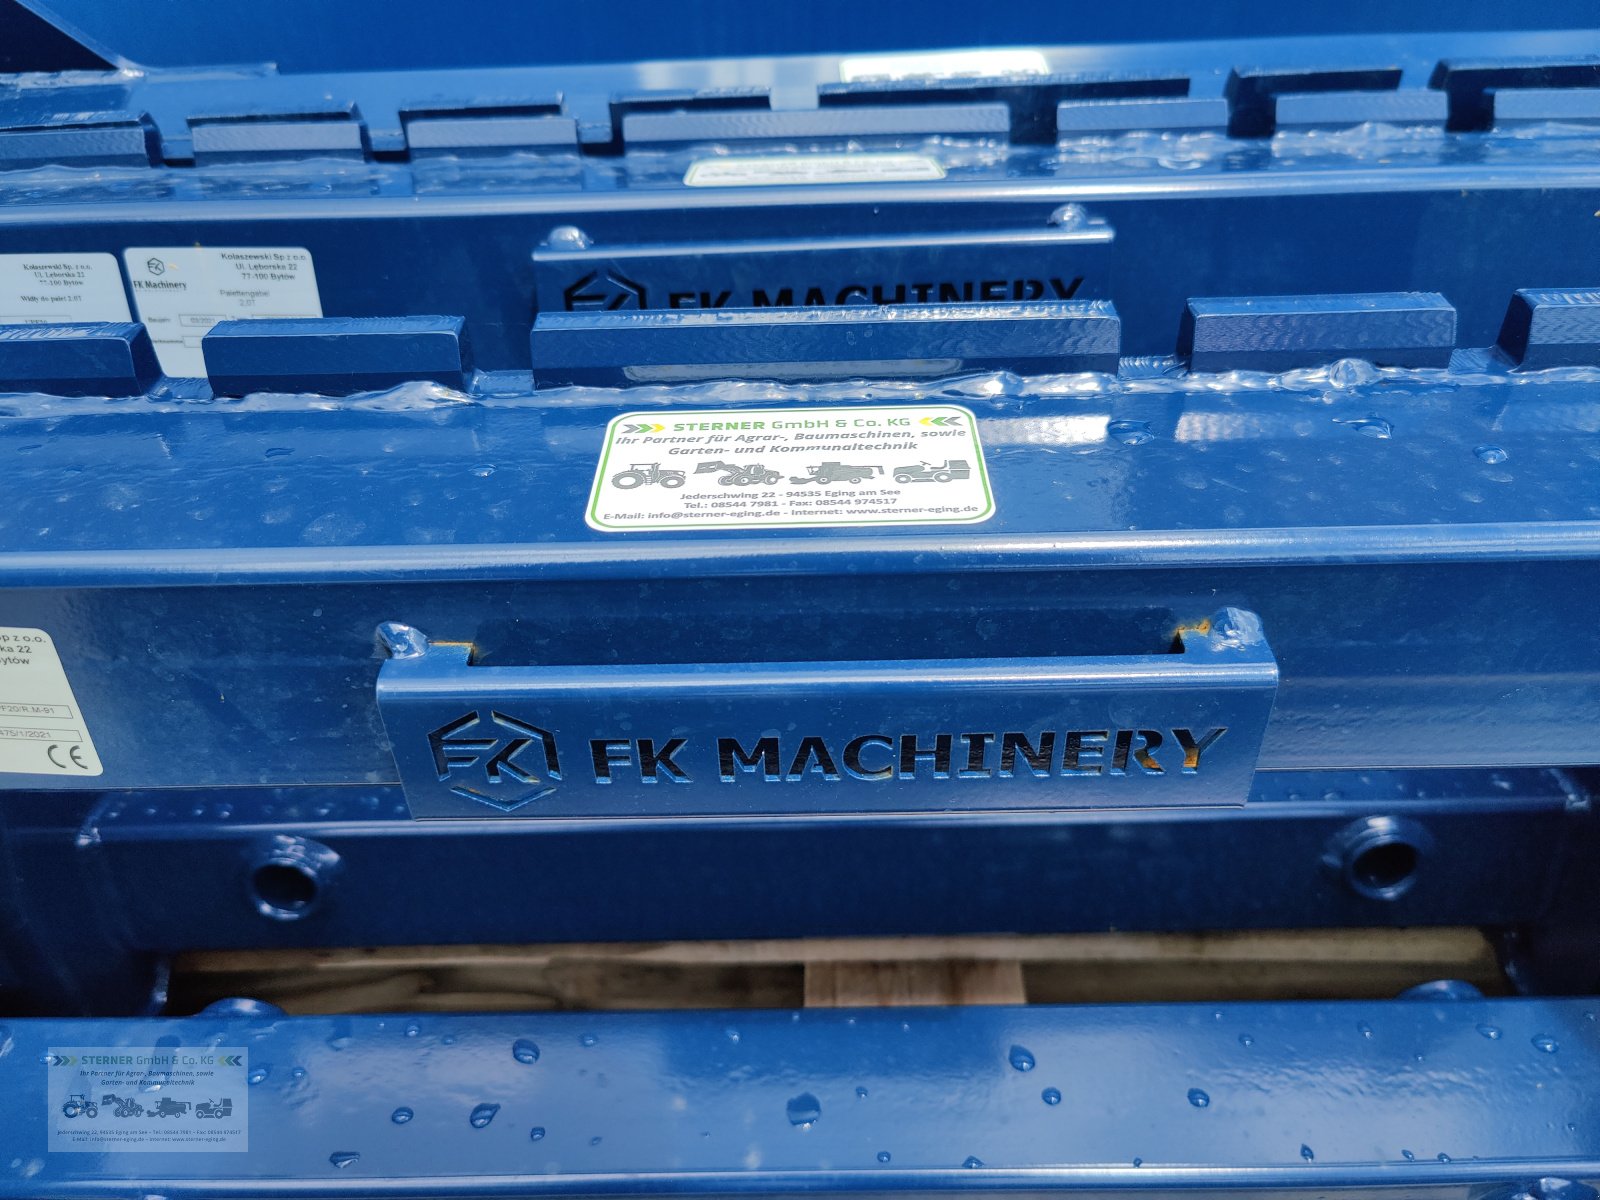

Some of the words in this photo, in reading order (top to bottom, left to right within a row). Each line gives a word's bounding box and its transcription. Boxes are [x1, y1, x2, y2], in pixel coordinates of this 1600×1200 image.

[133, 280, 144, 289] FK
[145, 280, 187, 291] Machinery
[673, 421, 766, 432] STERNER
[771, 419, 829, 430] GmbH
[834, 418, 848, 428] &
[853, 418, 882, 427] Co.
[887, 417, 911, 426] KG
[615, 436, 640, 445] Ihr
[642, 434, 704, 445] Partner
[705, 434, 732, 445] für
[734, 433, 788, 444] Agrar-,
[794, 430, 915, 440] Baumaschinen,
[920, 428, 967, 438] sowie
[668, 446, 730, 456] Garten-
[734, 445, 766, 454] und
[769, 441, 918, 454] Kommunaltechnik
[680, 491, 759, 501] Jederschwing
[760, 491, 776, 499] 22
[786, 489, 822, 498] 94535
[824, 489, 856, 499] Eging
[858, 489, 877, 497] am
[879, 488, 901, 496] See
[684, 501, 708, 509] Tel.:
[710, 501, 747, 509] 08544
[750, 500, 778, 508] 7981
[789, 499, 813, 507] Fax:
[815, 498, 851, 506] 08544
[853, 497, 898, 506] 974517
[603, 512, 645, 520] E-Mail:
[647, 509, 780, 519] info@sterner-eging.de
[791, 507, 843, 516] Internet:
[845, 505, 979, 516] www.sterner-eging.de
[22, 635, 47, 643] o.o.
[16, 645, 33, 654] 22
[0, 656, 30, 666] ytów
[589, 738, 694, 784] FK
[716, 726, 1228, 784] MACHINERY
